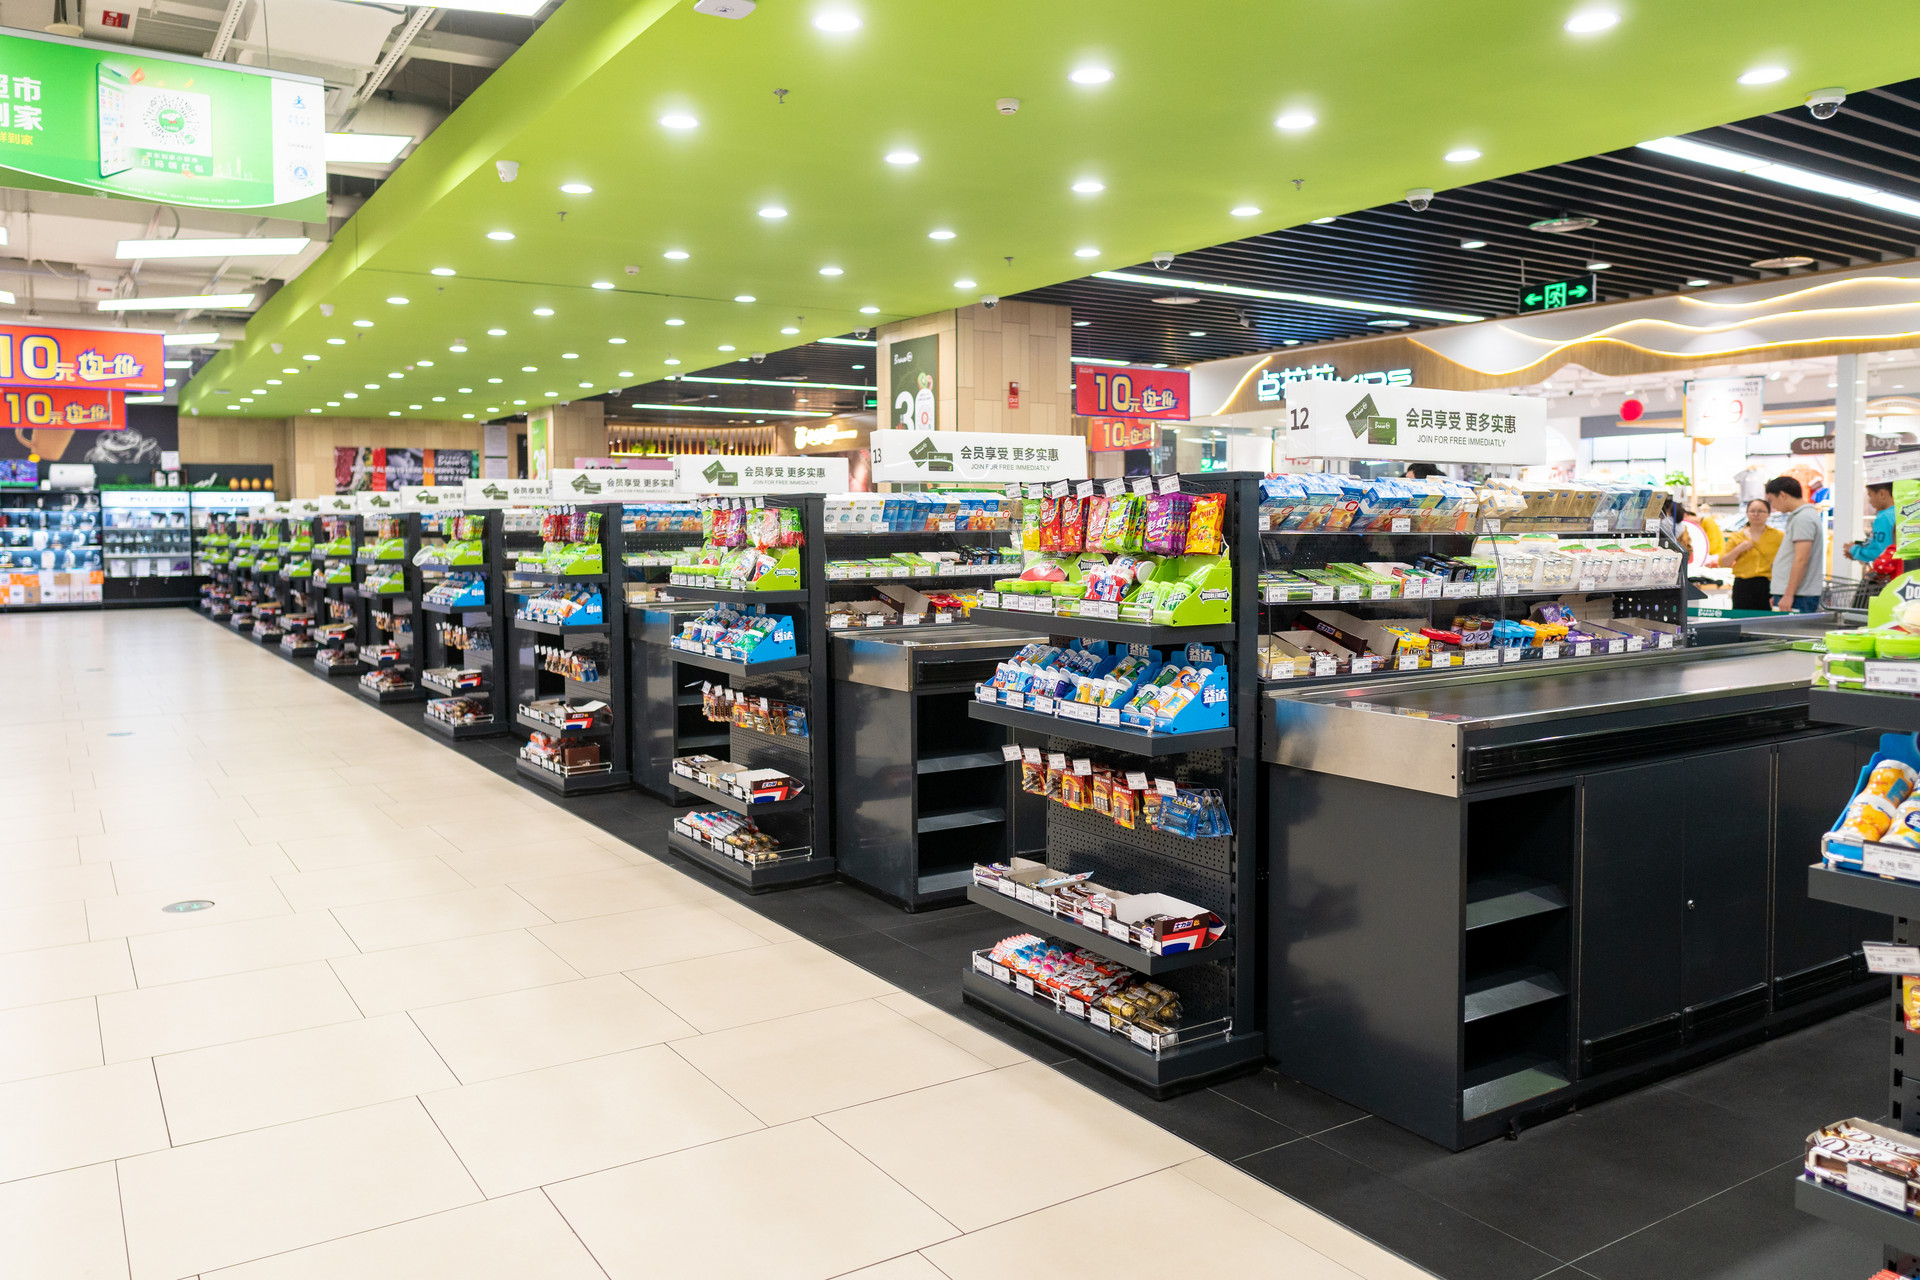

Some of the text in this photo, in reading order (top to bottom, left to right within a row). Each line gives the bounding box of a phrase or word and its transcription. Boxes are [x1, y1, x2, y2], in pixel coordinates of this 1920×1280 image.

[1290, 407, 1309, 431] 12
[1406, 407, 1517, 434] 会员享受 更多实惠
[1417, 435, 1507, 448] JOIN FOR FREE IMMEDIATLY
[873, 448, 882, 464] 13
[960, 445, 1059, 462] 会员享受 更多实惠
[424, 467, 434, 475] TO
[744, 466, 826, 478] 会员享受 更多实惠
[606, 478, 640, 488] 会员享受
[1189, 648, 1213, 662] 益达
[1203, 686, 1228, 704] 益达
[1821, 1137, 1882, 1162] Dove
